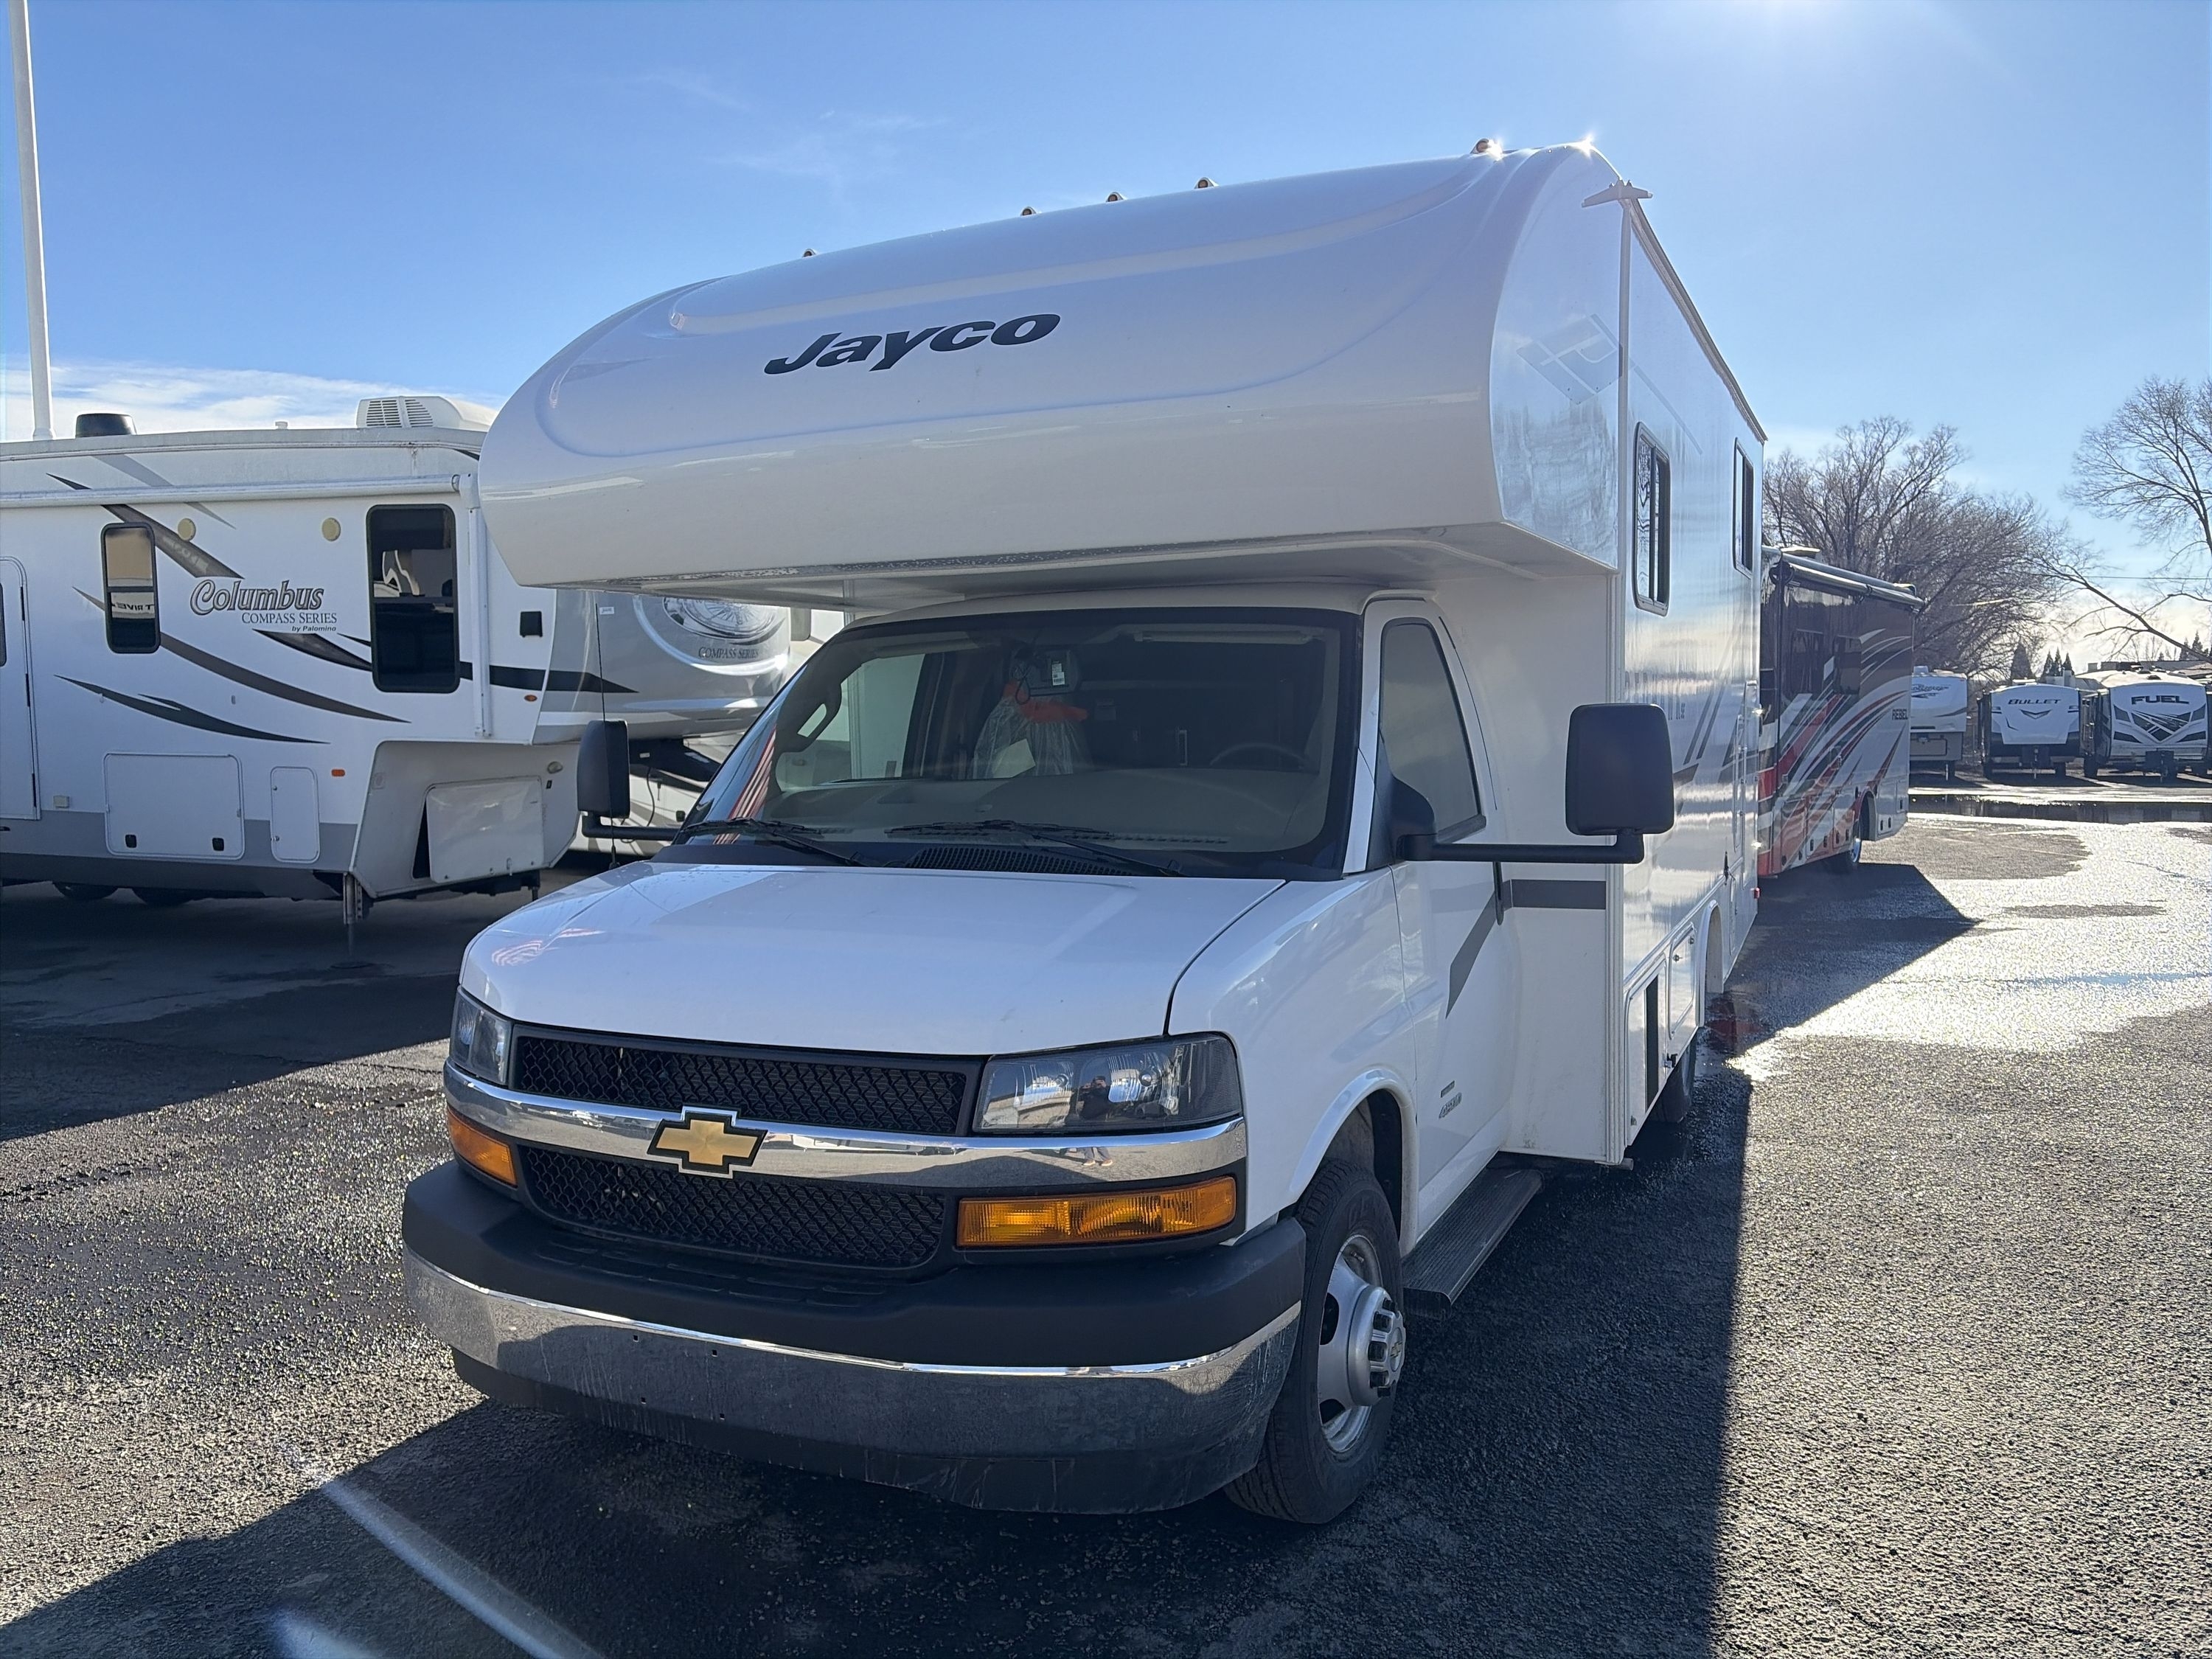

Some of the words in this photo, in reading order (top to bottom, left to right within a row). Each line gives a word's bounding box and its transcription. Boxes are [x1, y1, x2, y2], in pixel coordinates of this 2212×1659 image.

[763, 313, 1061, 375] Jayco
[189, 577, 324, 616] Columbus
[241, 612, 296, 624] COMPASS
[299, 612, 338, 624] SERIES
[698, 646, 737, 658] COMPASS
[738, 648, 759, 658] SERIES
[2131, 695, 2189, 705] FUEL
